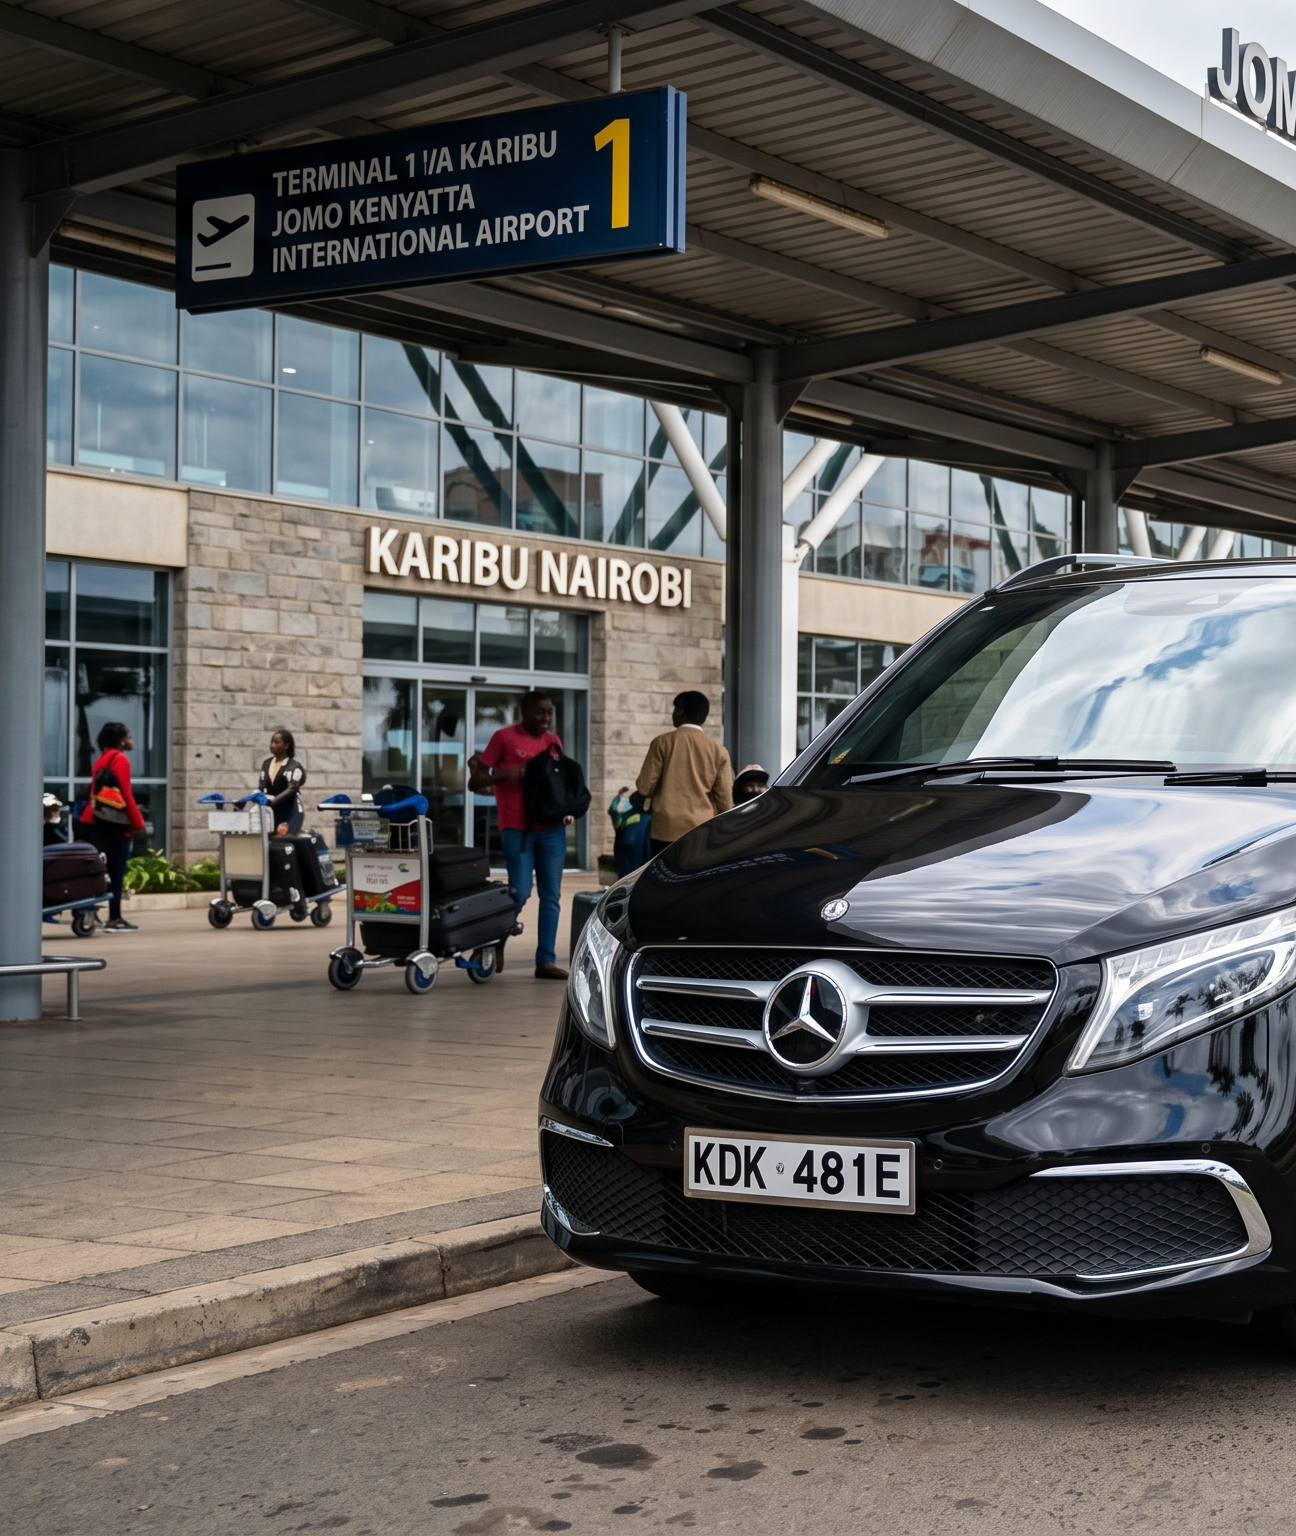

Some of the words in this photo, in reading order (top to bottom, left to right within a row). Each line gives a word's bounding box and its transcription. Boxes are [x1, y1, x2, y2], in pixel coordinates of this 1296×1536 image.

[272, 155, 398, 198] TERMINAL
[460, 130, 557, 170] KARIBU
[594, 118, 631, 230] 1
[272, 202, 343, 237] JOMO
[349, 183, 475, 227] KENYATTA
[272, 224, 469, 274] INTERNATIONAL
[475, 205, 590, 248] AIRPORT
[365, 526, 529, 591] KARIBU
[538, 550, 692, 609] NAIROBI
[694, 1141, 767, 1190] KDK
[793, 1149, 900, 1199] 481E
